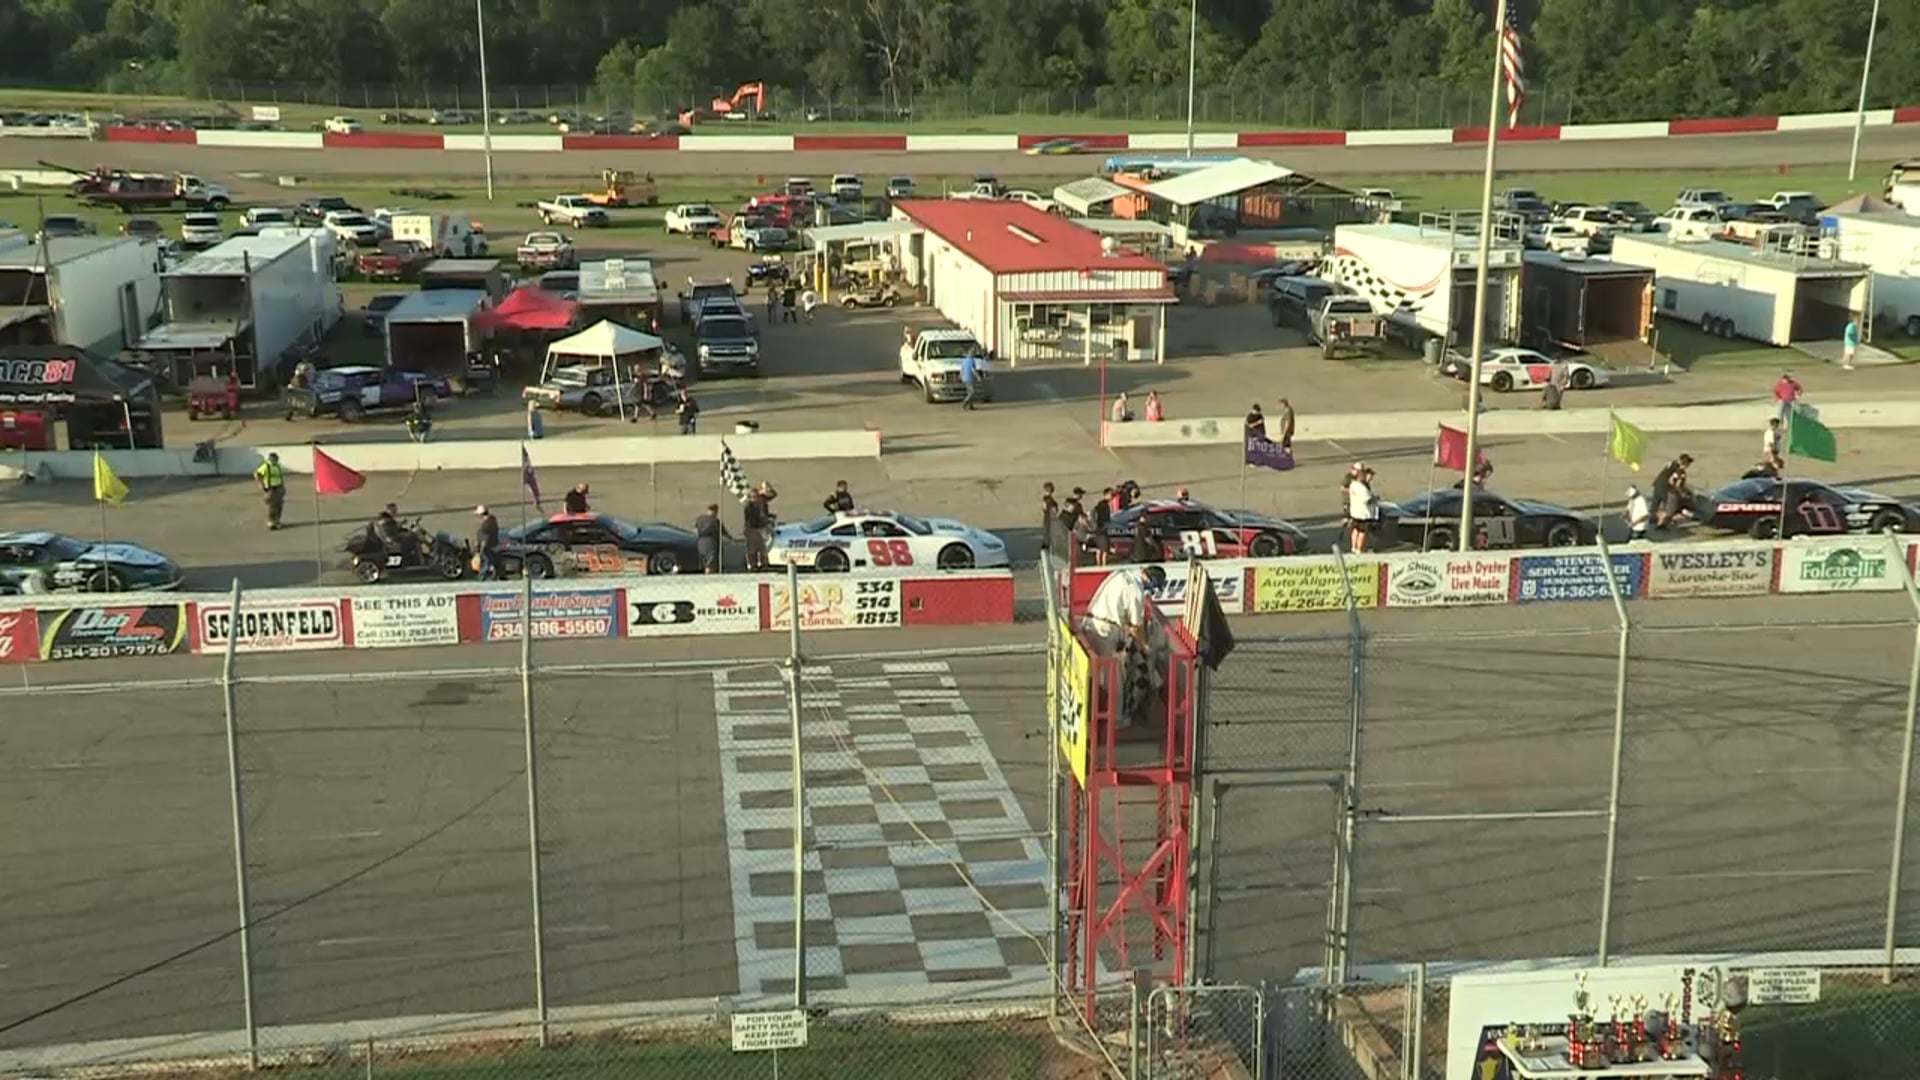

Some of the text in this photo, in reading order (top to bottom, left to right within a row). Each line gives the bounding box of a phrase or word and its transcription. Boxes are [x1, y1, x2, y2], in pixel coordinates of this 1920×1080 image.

[1799, 504, 1842, 530] 11
[1180, 530, 1217, 556] 81
[868, 539, 913, 566] 98
[1659, 552, 1767, 569] WESLEY'S
[1446, 561, 1507, 575] Fresh Oyster
[1528, 565, 1631, 577] SERVICE CENER
[1802, 560, 1884, 579] Folcarelli's
[856, 581, 894, 594] 334
[1262, 579, 1296, 588] Auto
[1451, 576, 1500, 590] Live Music
[1289, 588, 1330, 597] Brake
[354, 597, 455, 610] SEE THIS AD?
[856, 596, 891, 609] 514
[208, 610, 334, 638] SCHOENFELD
[856, 611, 899, 625] 1813
[357, 630, 377, 638] Call
[493, 619, 606, 637] 334396-5560
[736, 1021, 804, 1032] SAFETY PLEASE
